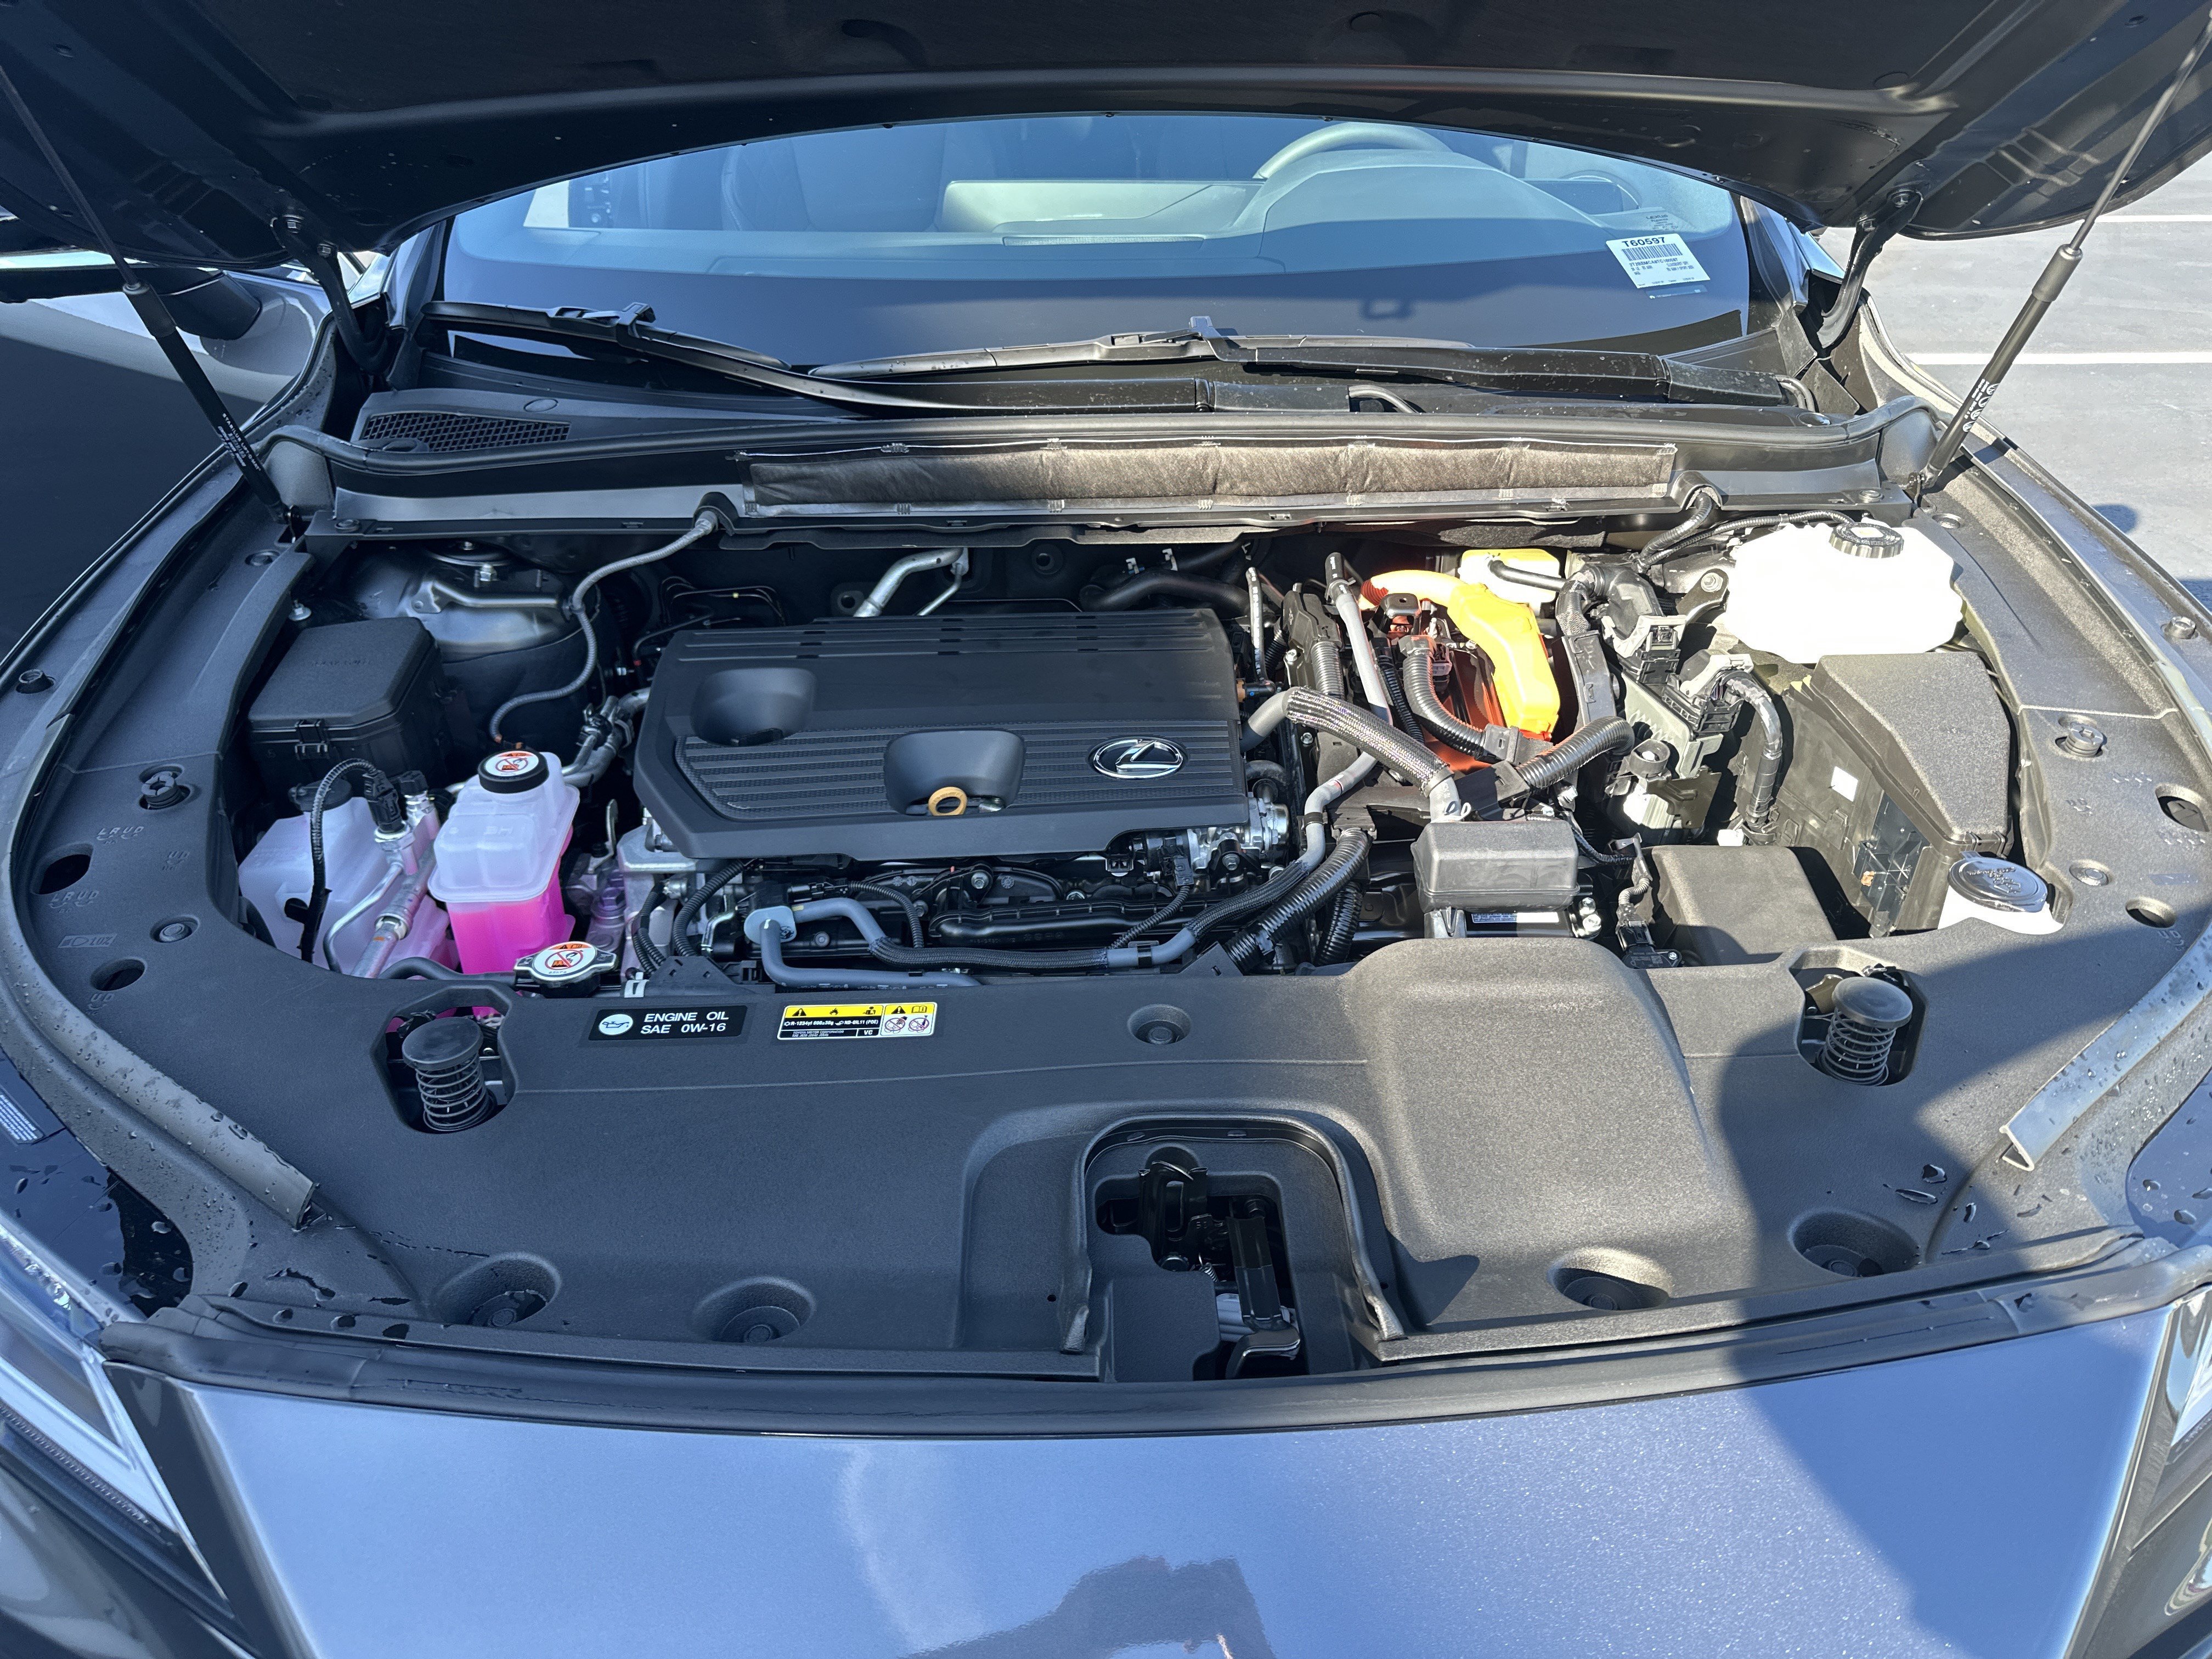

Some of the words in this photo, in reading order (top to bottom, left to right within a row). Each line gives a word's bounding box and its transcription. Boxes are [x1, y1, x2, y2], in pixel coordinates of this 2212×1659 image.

[1622, 236, 1665, 247] T60597
[644, 1012, 698, 1022] ENGINE
[706, 1011, 729, 1020] OIL
[640, 1024, 672, 1034] SAE
[680, 1023, 726, 1032] 0W-16
